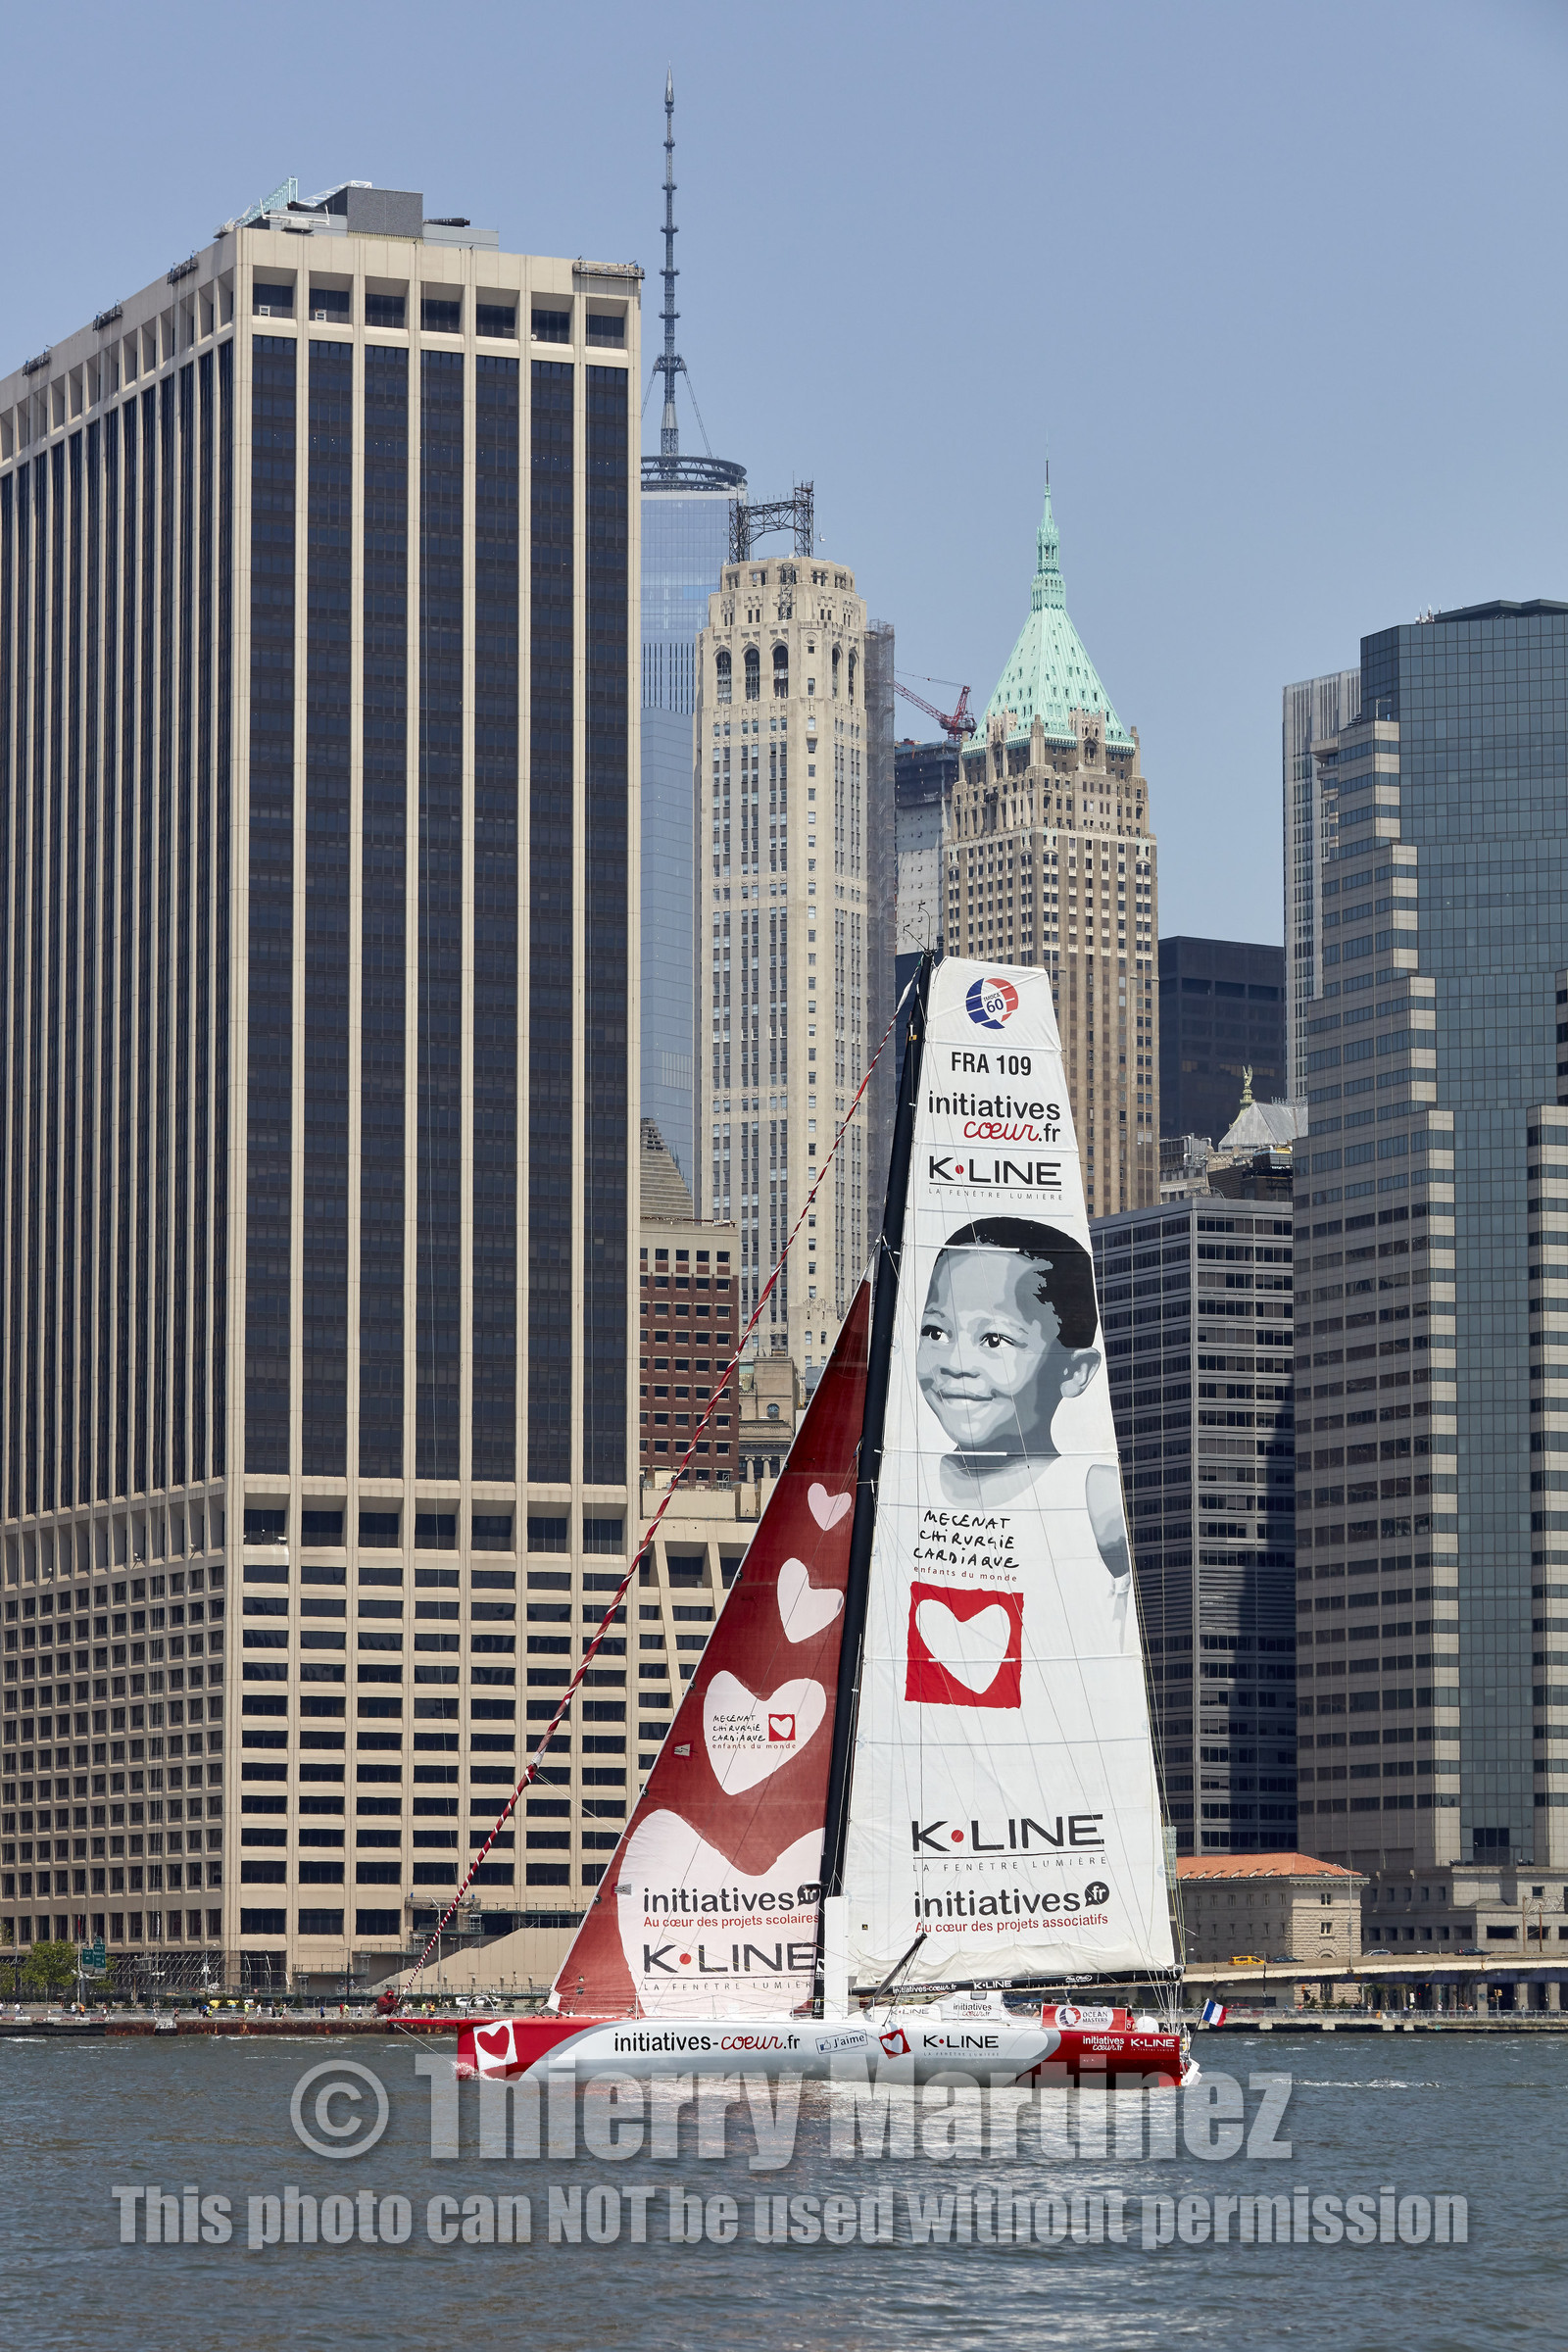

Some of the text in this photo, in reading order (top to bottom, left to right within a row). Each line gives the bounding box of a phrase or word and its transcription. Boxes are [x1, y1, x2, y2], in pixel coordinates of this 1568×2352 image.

[987, 999, 1004, 1012] 60
[952, 1052, 1032, 1076] FRA 109
[929, 1090, 1060, 1120] initiatives
[913, 1566, 956, 1577] enfants
[643, 1886, 795, 1913] initiatives
[914, 1888, 1081, 1918] initiatives
[644, 1917, 660, 1927] Au
[697, 1916, 718, 1927] des
[721, 1915, 762, 1929] projets
[765, 1913, 819, 1925] scolaires
[915, 1923, 932, 1934] Au
[971, 1920, 993, 1932] des
[997, 1918, 1039, 1933] projets
[1043, 1913, 1108, 1928] associatifs
[833, 2034, 864, 2048] J'aime
[1083, 2035, 1124, 2045] initiatives
